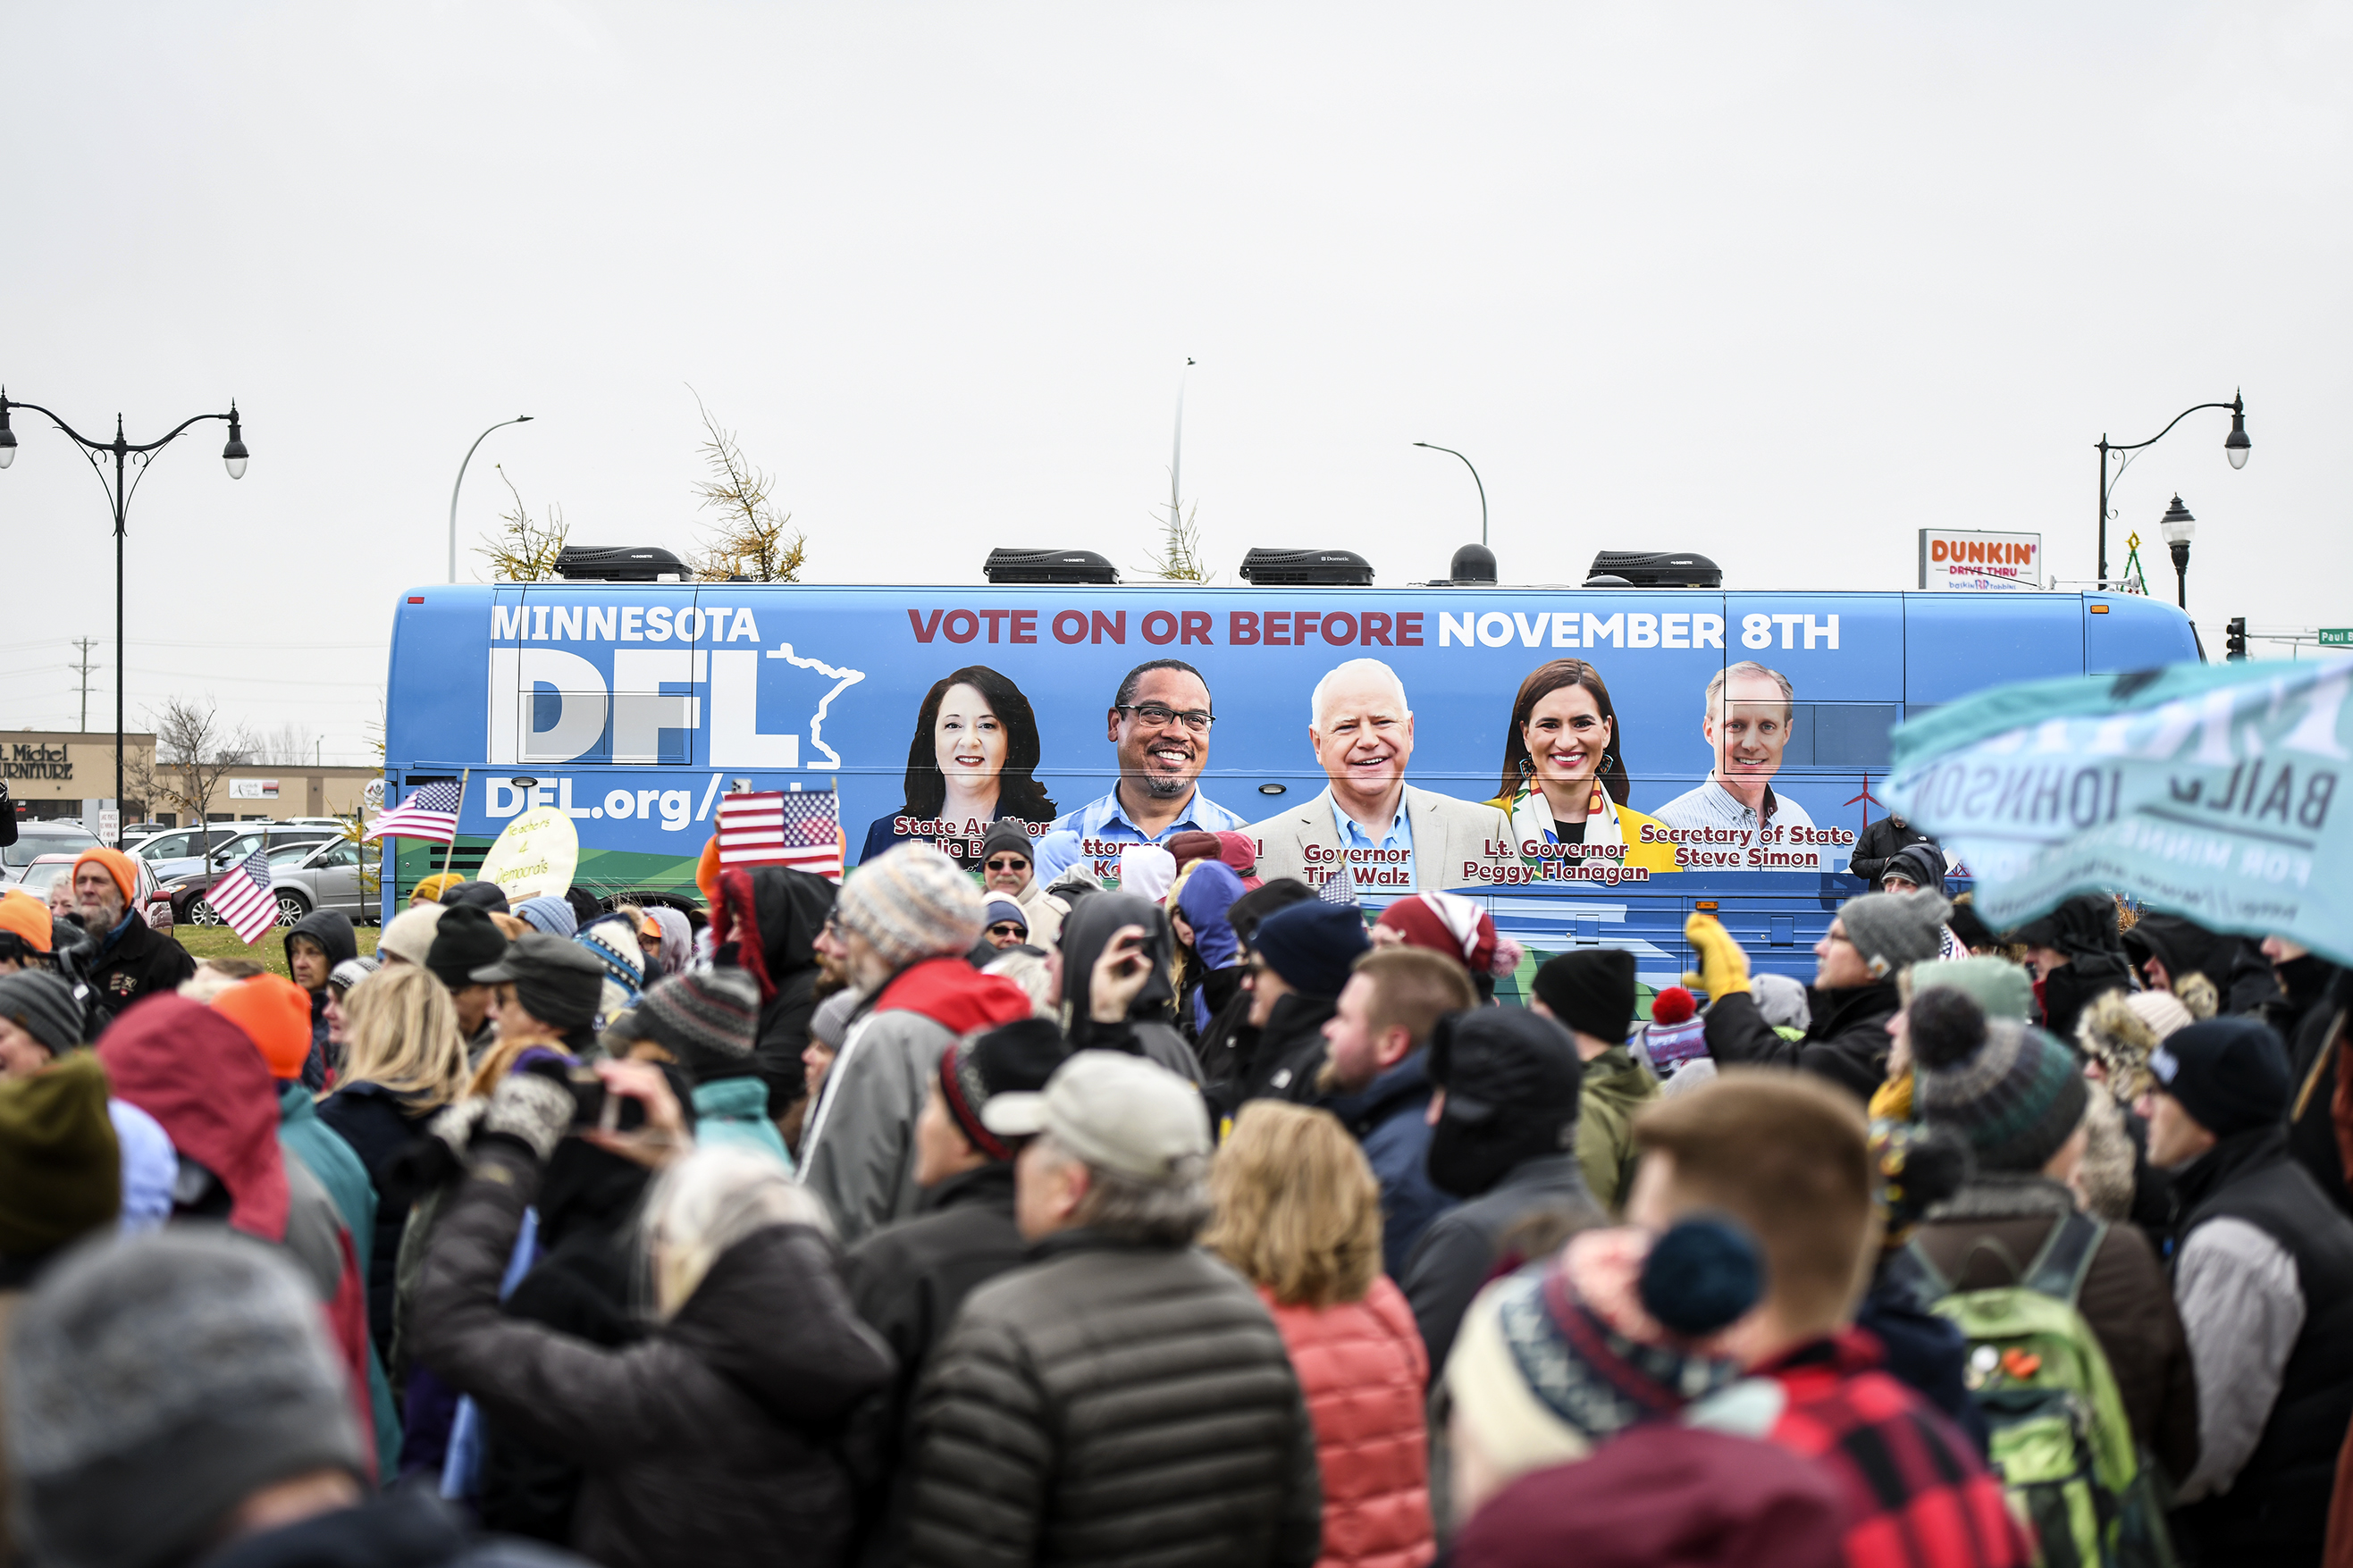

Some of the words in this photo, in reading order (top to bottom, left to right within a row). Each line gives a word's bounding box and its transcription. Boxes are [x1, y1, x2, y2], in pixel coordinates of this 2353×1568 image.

[1931, 539, 2037, 565] DUNKIN'
[1949, 566, 1983, 575] DRIVE
[1987, 566, 2018, 577] THRU
[491, 606, 761, 642] MINNESOTA
[908, 608, 1038, 644] VOTE
[1052, 609, 1126, 645] ON
[1141, 610, 1214, 646] OR
[1230, 611, 1424, 647] BEFORE
[1439, 612, 1726, 649] NOVEMBER
[1741, 614, 1841, 650] 8TH
[2321, 632, 2344, 641] Paul
[487, 648, 799, 767] DFL
[13, 742, 68, 762] Michel
[0, 762, 73, 780] URNITURE
[485, 773, 840, 832] DFL.org/
[508, 818, 550, 837] Teachers
[894, 816, 957, 836] State
[1639, 824, 1753, 847] Secretary
[1760, 824, 1785, 843] of
[1790, 825, 1854, 844] State
[518, 840, 530, 856] 4
[1304, 843, 1412, 863] Governor
[1483, 838, 1515, 858] Lt.
[1521, 838, 1629, 859] Governor
[1674, 847, 1741, 868] Steve
[1747, 847, 1819, 868] Simon
[495, 856, 550, 885] Democrats
[1352, 867, 1411, 885] Walz
[1463, 860, 1535, 885] Peggy
[1542, 861, 1650, 885] Flanagan
